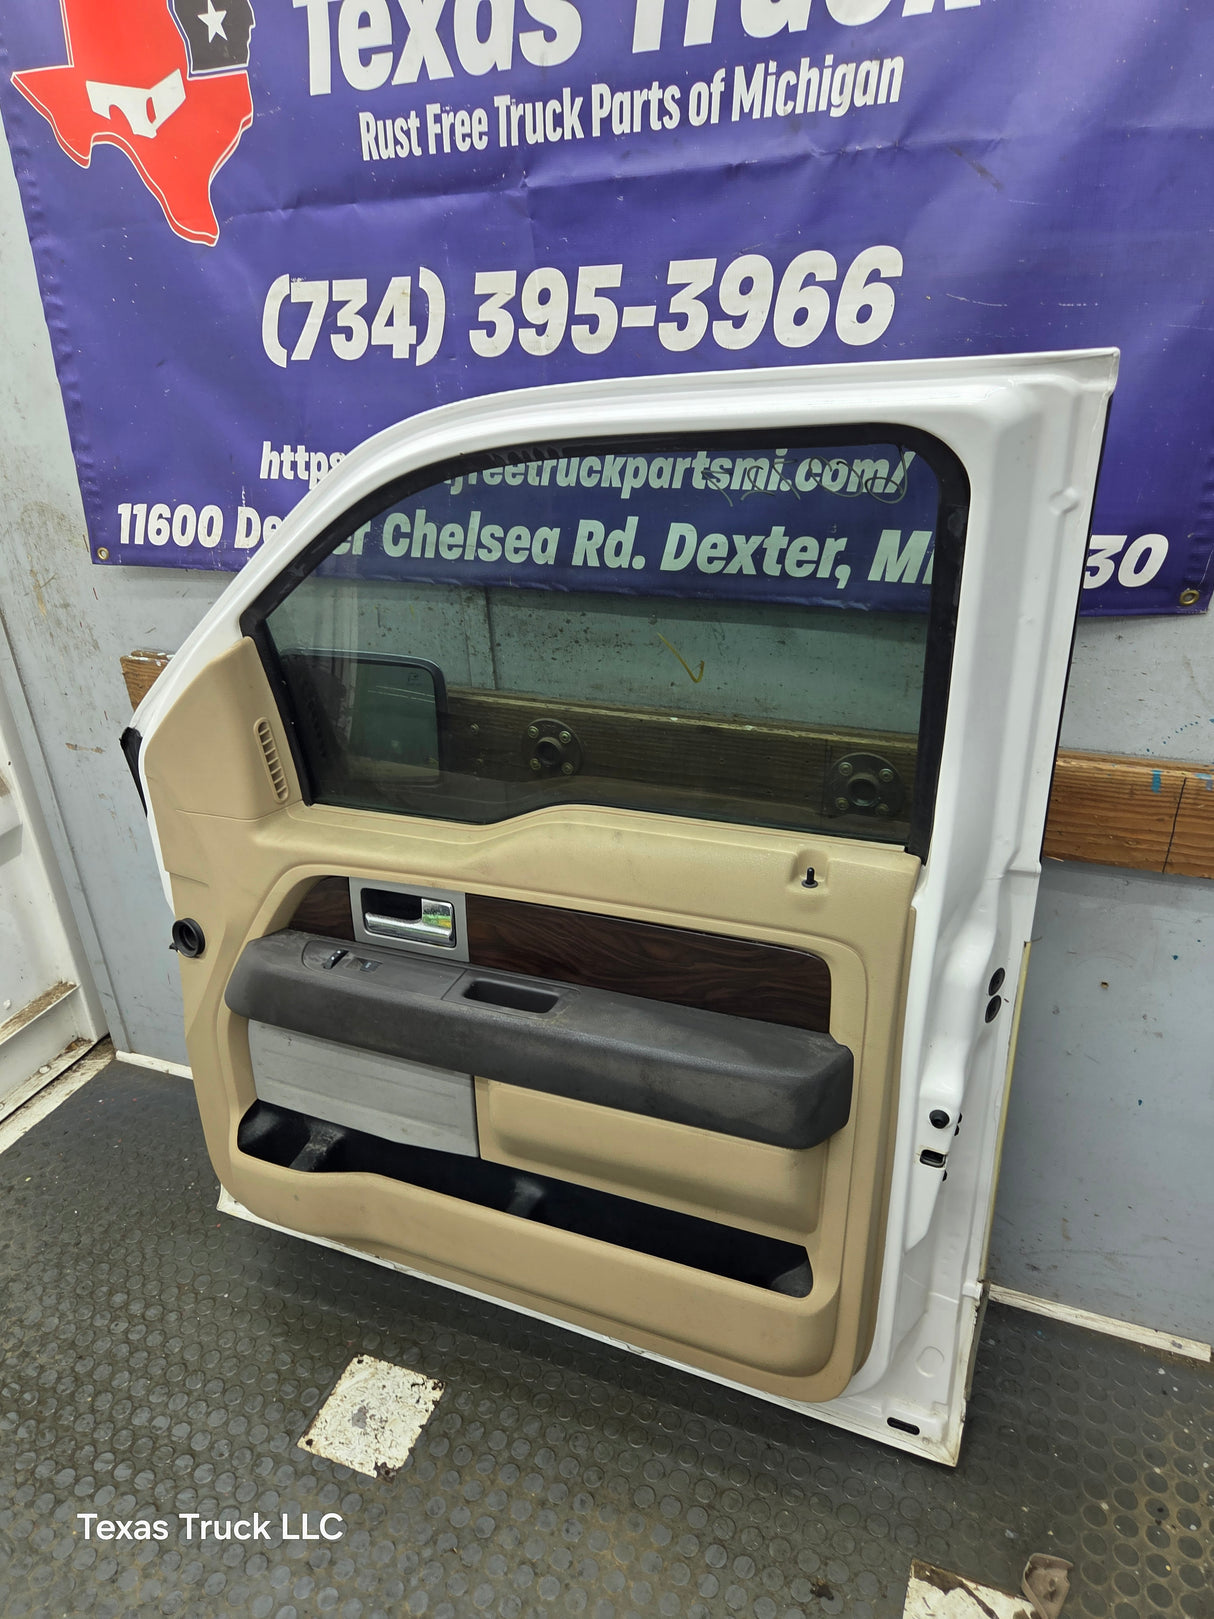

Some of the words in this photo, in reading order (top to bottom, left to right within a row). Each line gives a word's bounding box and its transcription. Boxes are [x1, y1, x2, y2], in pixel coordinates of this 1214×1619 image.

[292, 0, 582, 96] Texas
[358, 110, 423, 162] Rust
[425, 102, 489, 155] Free
[493, 86, 585, 148] Truck
[591, 80, 681, 138] Parts
[688, 67, 726, 127] of
[730, 53, 905, 122] Michigan
[261, 266, 447, 368] (734)
[468, 245, 904, 357] 395-3966
[117, 502, 225, 549] 11600
[381, 508, 562, 566] Chelsea
[571, 515, 647, 571] Rd.
[659, 522, 852, 590] Dexter,
